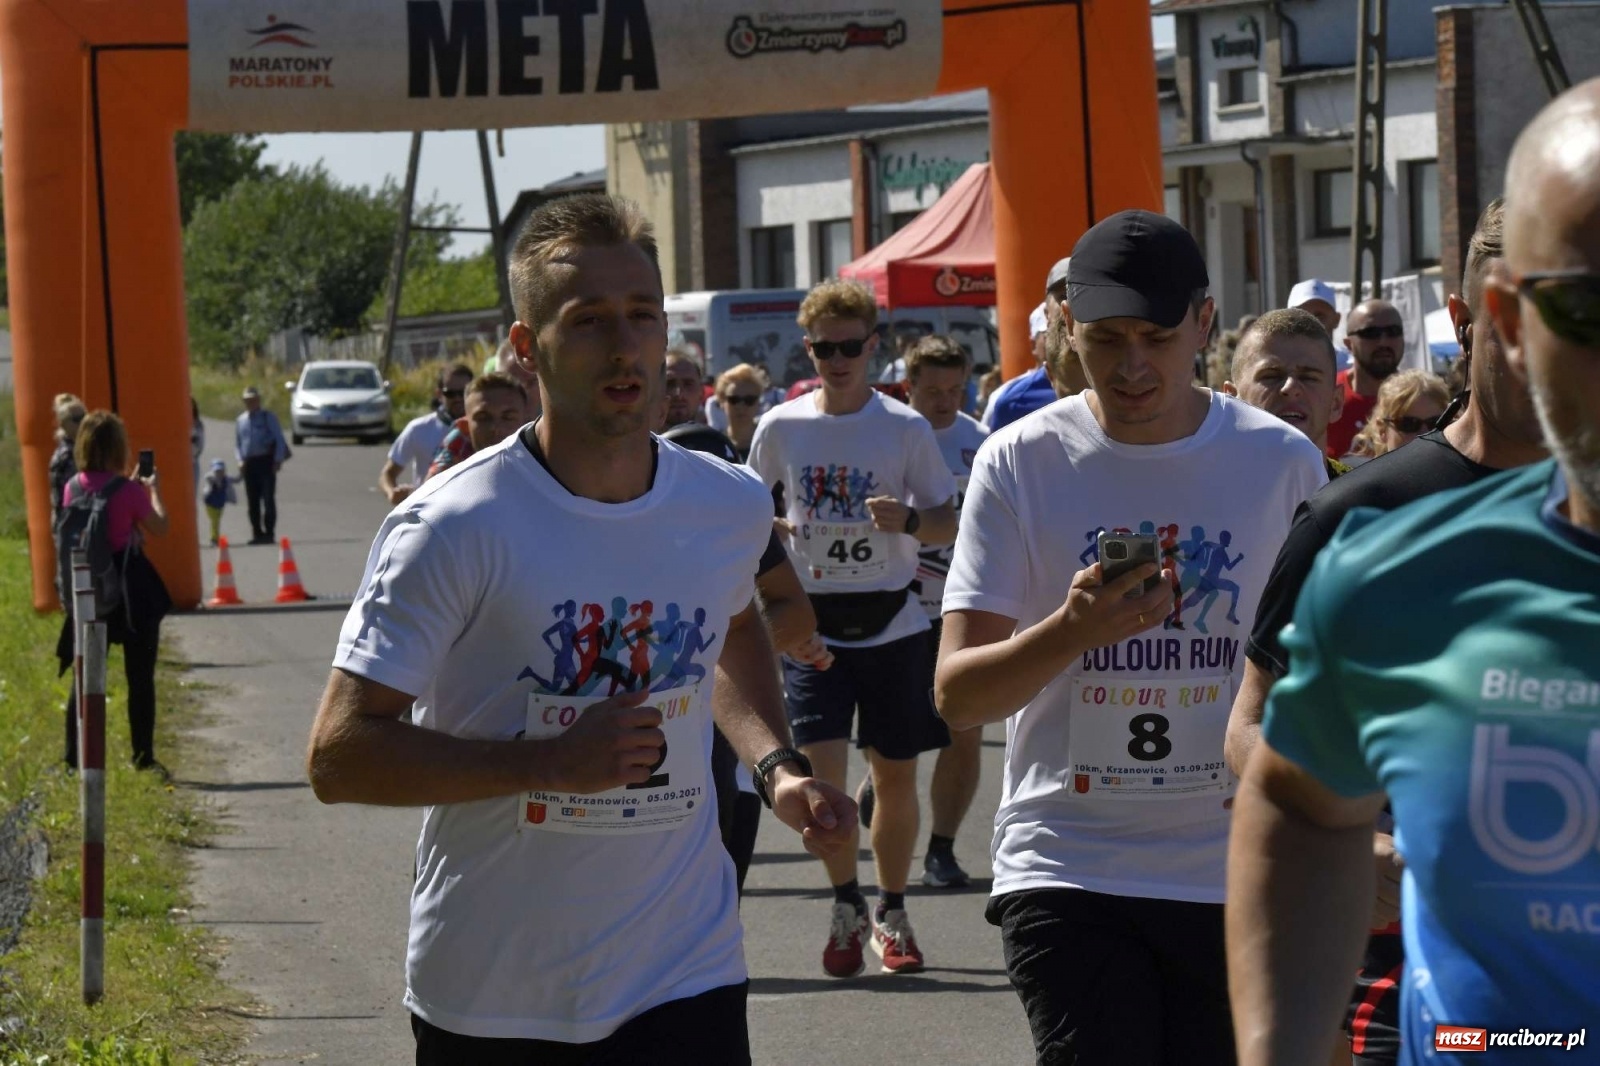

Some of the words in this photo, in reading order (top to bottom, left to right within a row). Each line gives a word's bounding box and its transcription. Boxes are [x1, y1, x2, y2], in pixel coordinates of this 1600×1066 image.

[407, 0, 660, 98] META
[229, 57, 334, 73] MARATONY
[228, 74, 335, 89] POLSKIE.PL
[827, 537, 873, 563] 46
[1190, 636, 1239, 672] RUN
[1082, 685, 1167, 709] COLOUR
[1179, 684, 1220, 708] RUN
[1127, 712, 1172, 762] 8
[1075, 765, 1102, 774] 10km,
[1107, 766, 1167, 775] Krzanowice,
[1174, 761, 1225, 773] 05.09.2021
[528, 791, 564, 804] 10km,
[569, 795, 641, 806] Krzanowice,
[646, 786, 702, 803] 05.09.2021
